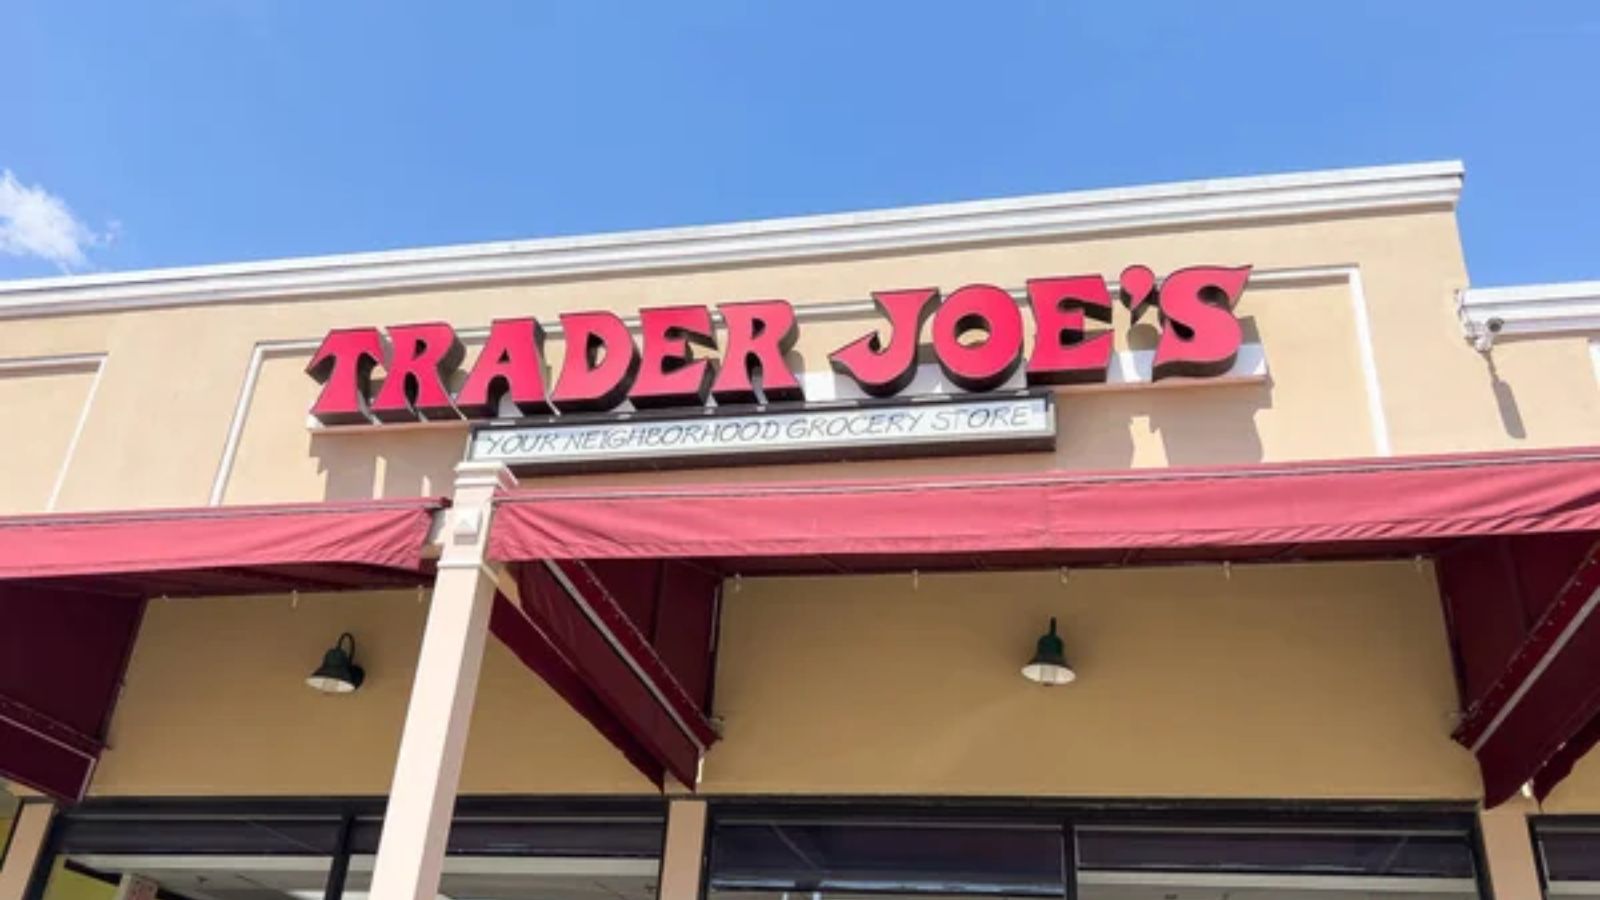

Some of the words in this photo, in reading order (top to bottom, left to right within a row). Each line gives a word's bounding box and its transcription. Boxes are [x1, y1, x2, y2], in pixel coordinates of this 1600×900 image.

[306, 299, 803, 421] TRADER
[829, 264, 1253, 393] JOE'S
[486, 433, 556, 455] YOUR
[564, 421, 779, 450] NEIGHBORHOOD
[786, 411, 925, 440] GROCERY
[931, 404, 1030, 431] STORE
